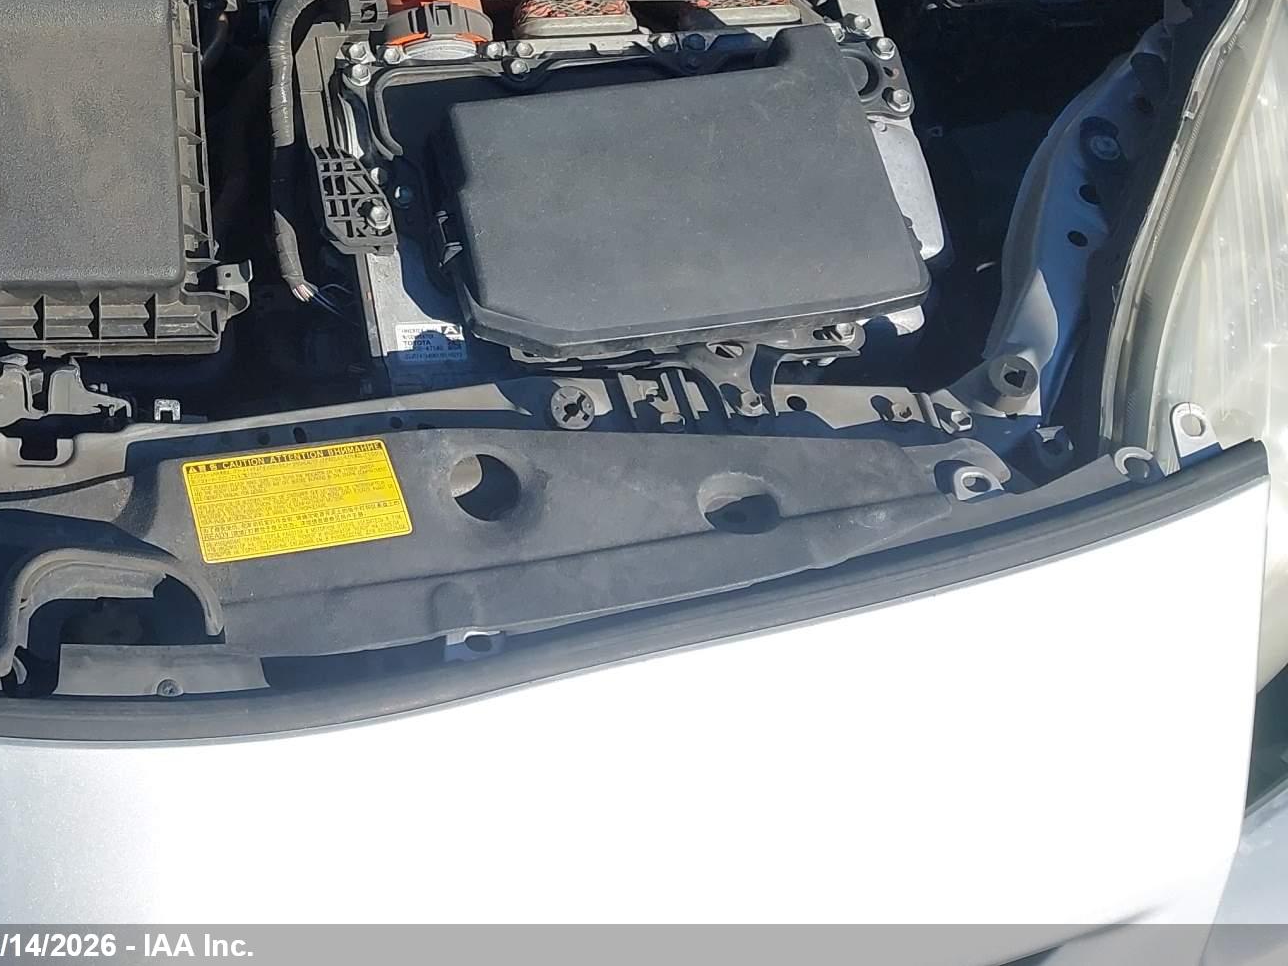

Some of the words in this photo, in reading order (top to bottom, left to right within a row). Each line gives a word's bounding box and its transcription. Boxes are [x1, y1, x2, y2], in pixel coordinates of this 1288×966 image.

[222, 457, 265, 469] CAUTION
[270, 449, 324, 464] ATTENTION
[328, 442, 381, 457] ВНИМАНИЕ
